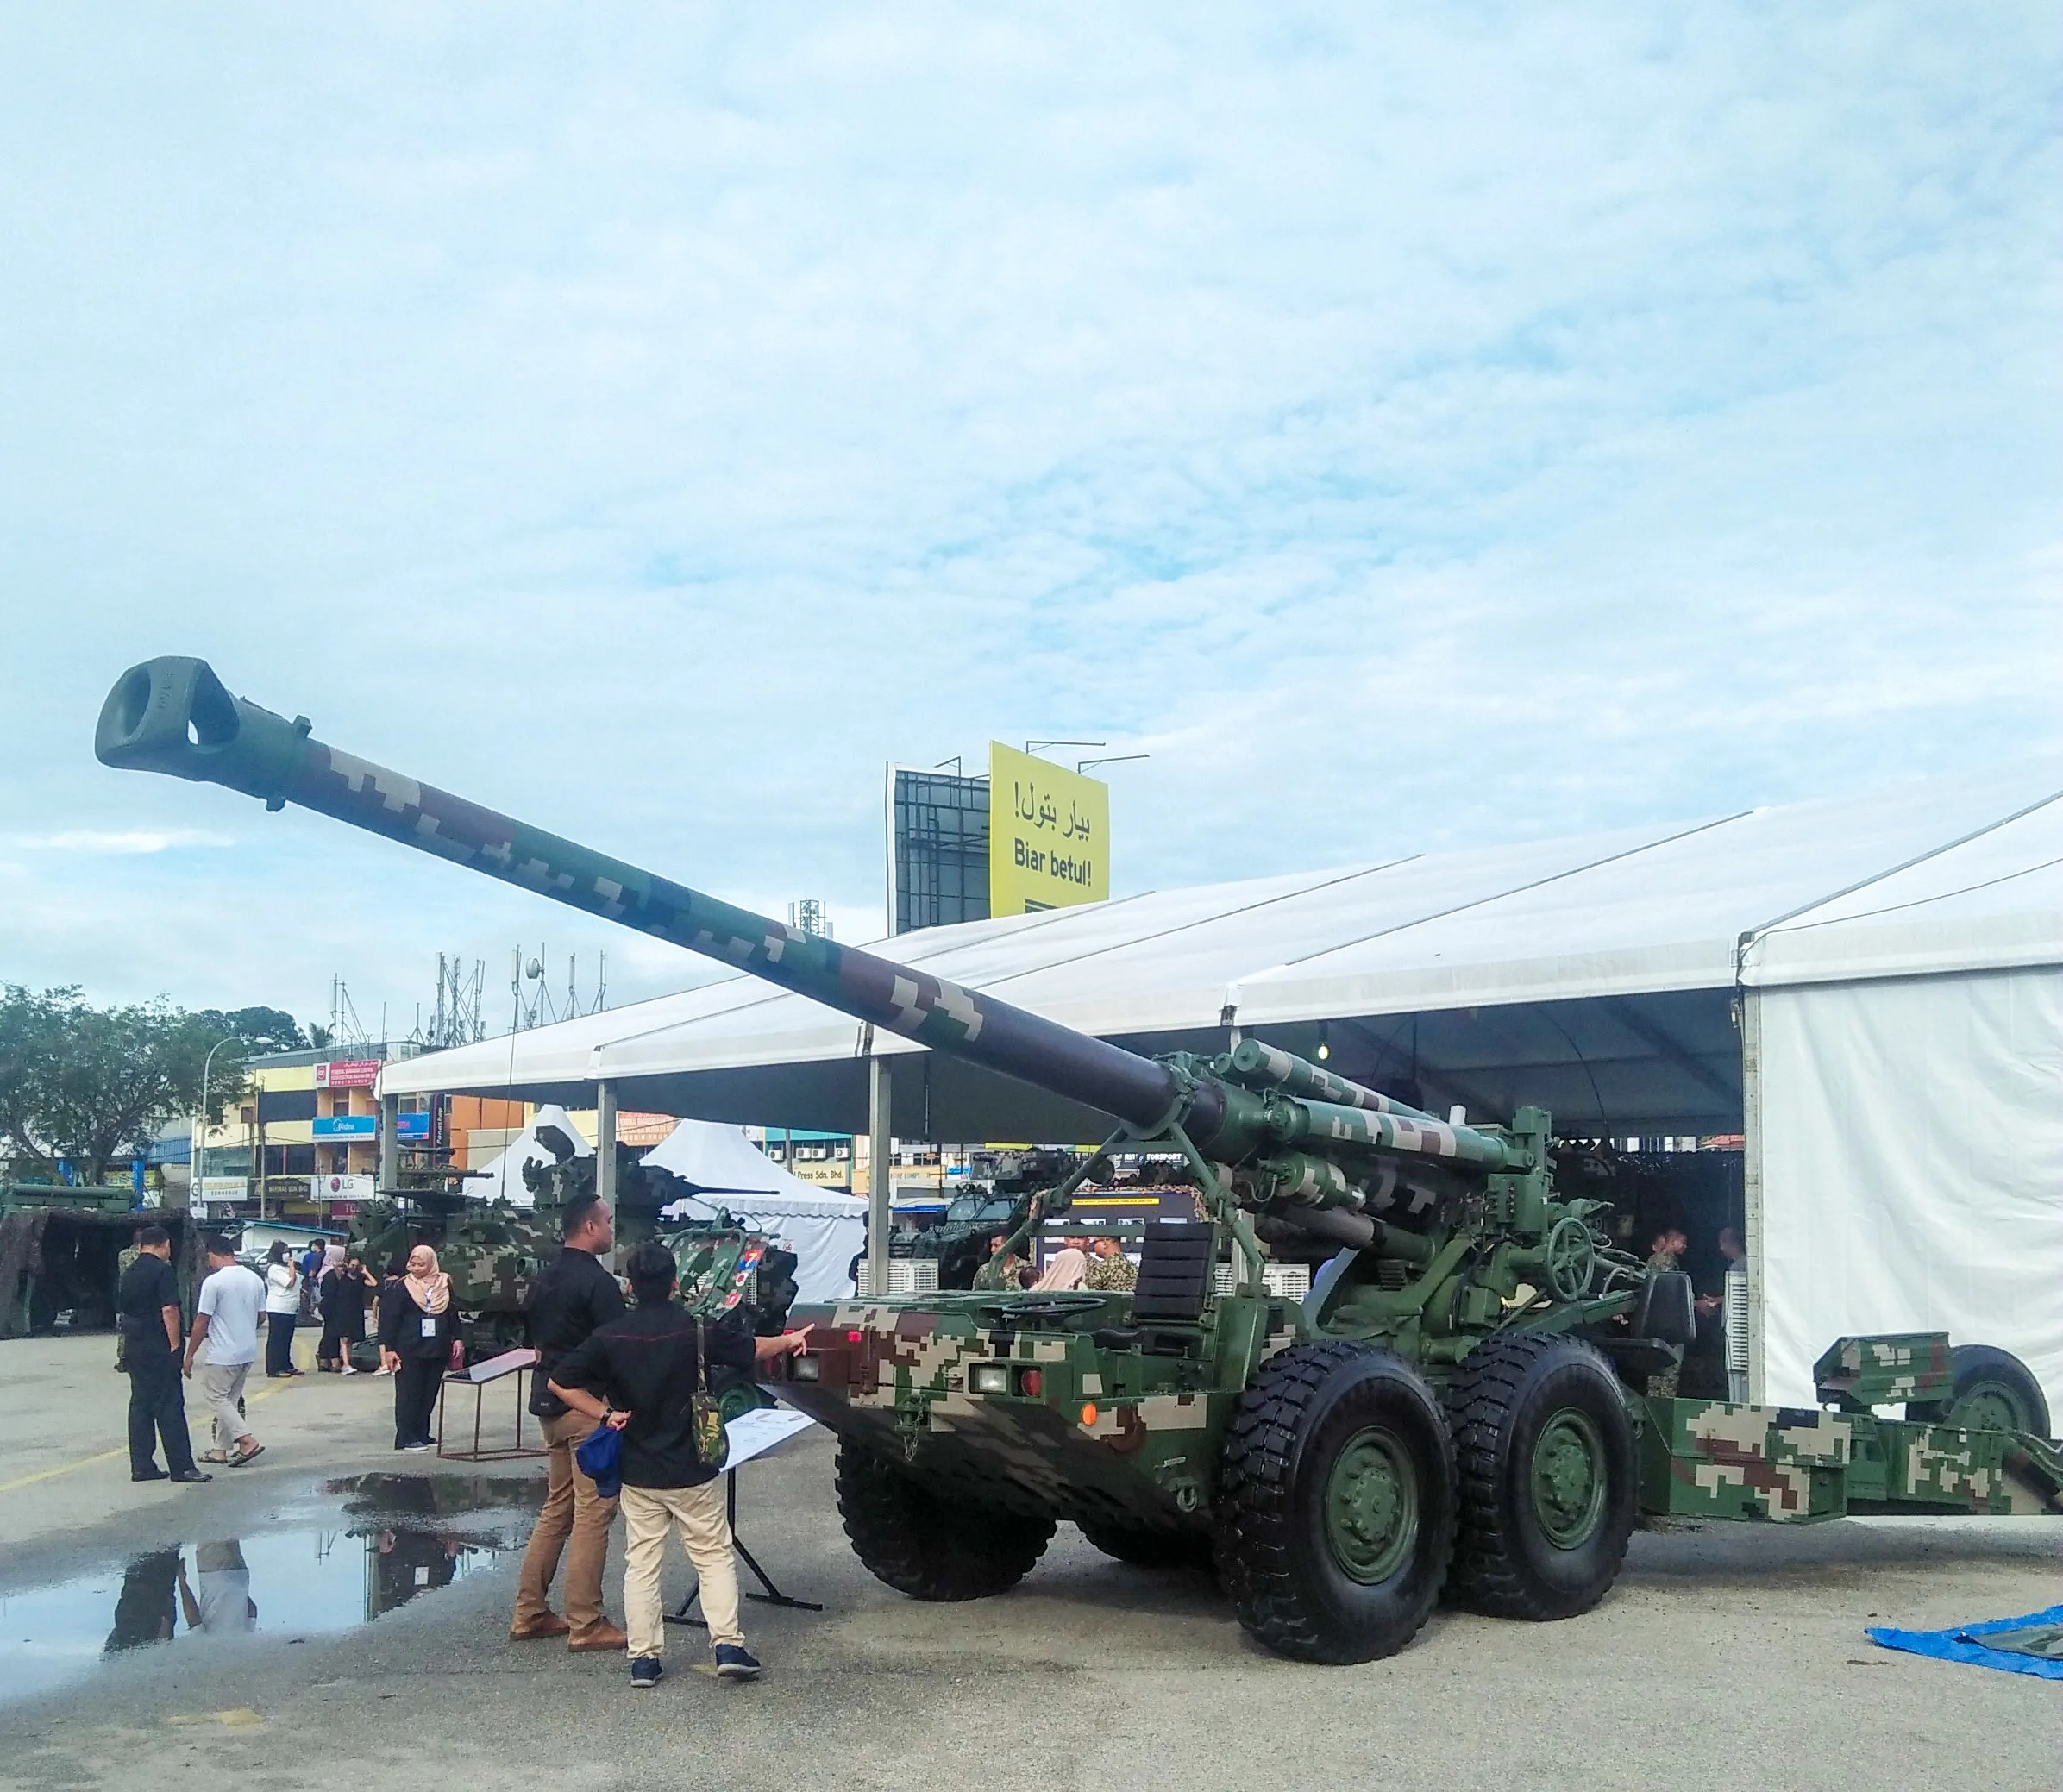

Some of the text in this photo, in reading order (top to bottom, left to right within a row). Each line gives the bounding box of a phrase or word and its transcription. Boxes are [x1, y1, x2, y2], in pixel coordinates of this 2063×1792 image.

[1014, 781, 1090, 843] بيار بتول!
[1014, 837, 1092, 887] Biar betul!
[797, 1171, 813, 1180] Press
[815, 1171, 829, 1180] Sdn.
[831, 1169, 843, 1179] Bhd.
[342, 1178, 354, 1190] LG
[745, 1252, 758, 1267] 7
